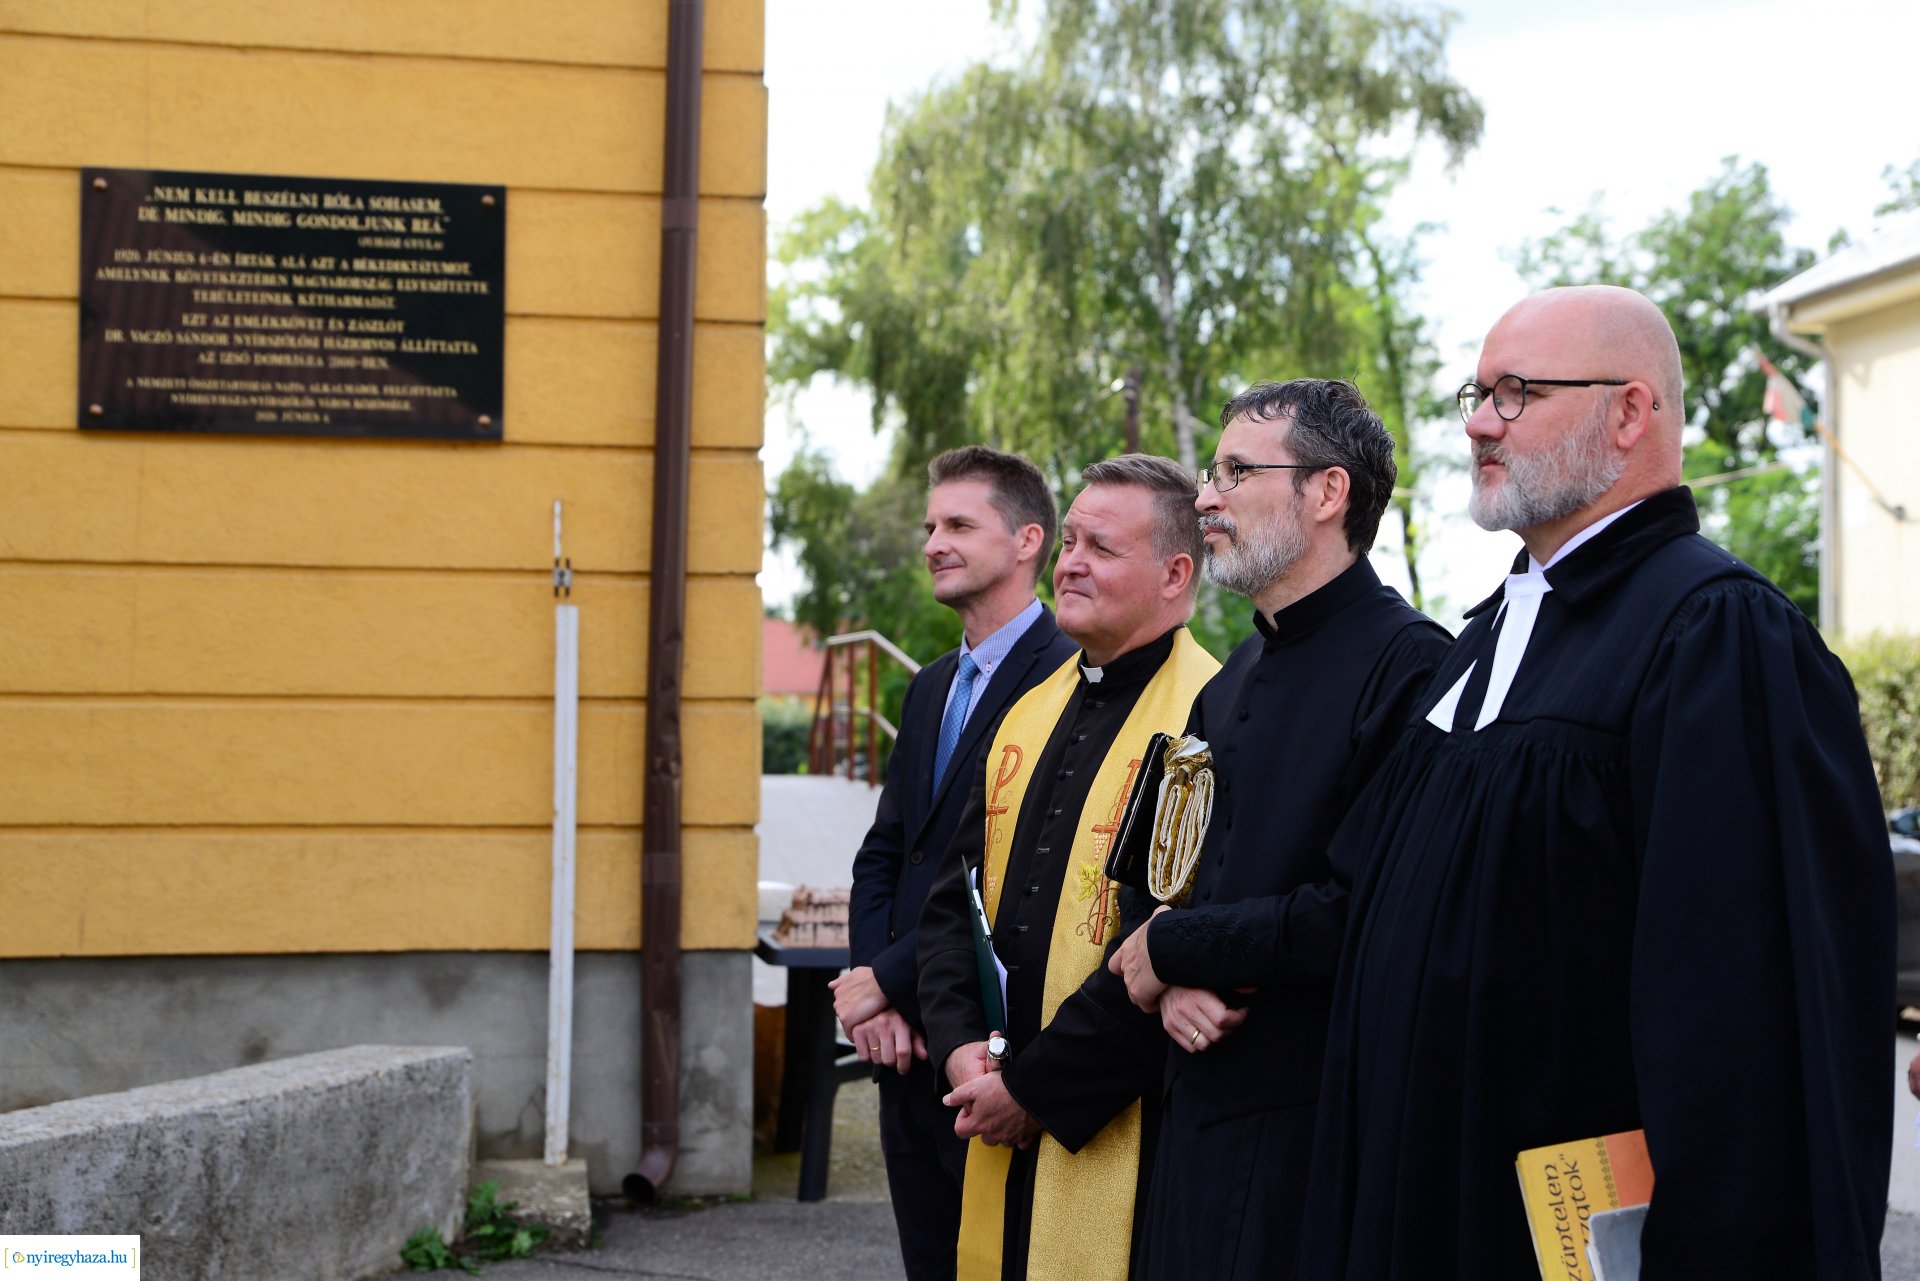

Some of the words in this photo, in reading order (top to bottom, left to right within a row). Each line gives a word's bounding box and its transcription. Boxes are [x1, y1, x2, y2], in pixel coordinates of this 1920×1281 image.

[195, 189, 240, 205] KELL
[323, 194, 364, 210] RÓLA
[138, 206, 160, 221] DE
[233, 211, 292, 227] MINDIG
[296, 213, 407, 232] GONDOLJUNK
[280, 257, 307, 270] ALÁ
[311, 257, 335, 271] AZT
[340, 260, 350, 270] A
[182, 313, 208, 326] EZT
[212, 315, 231, 327] AZ
[328, 319, 345, 331] ÉS
[198, 351, 217, 364] AZ
